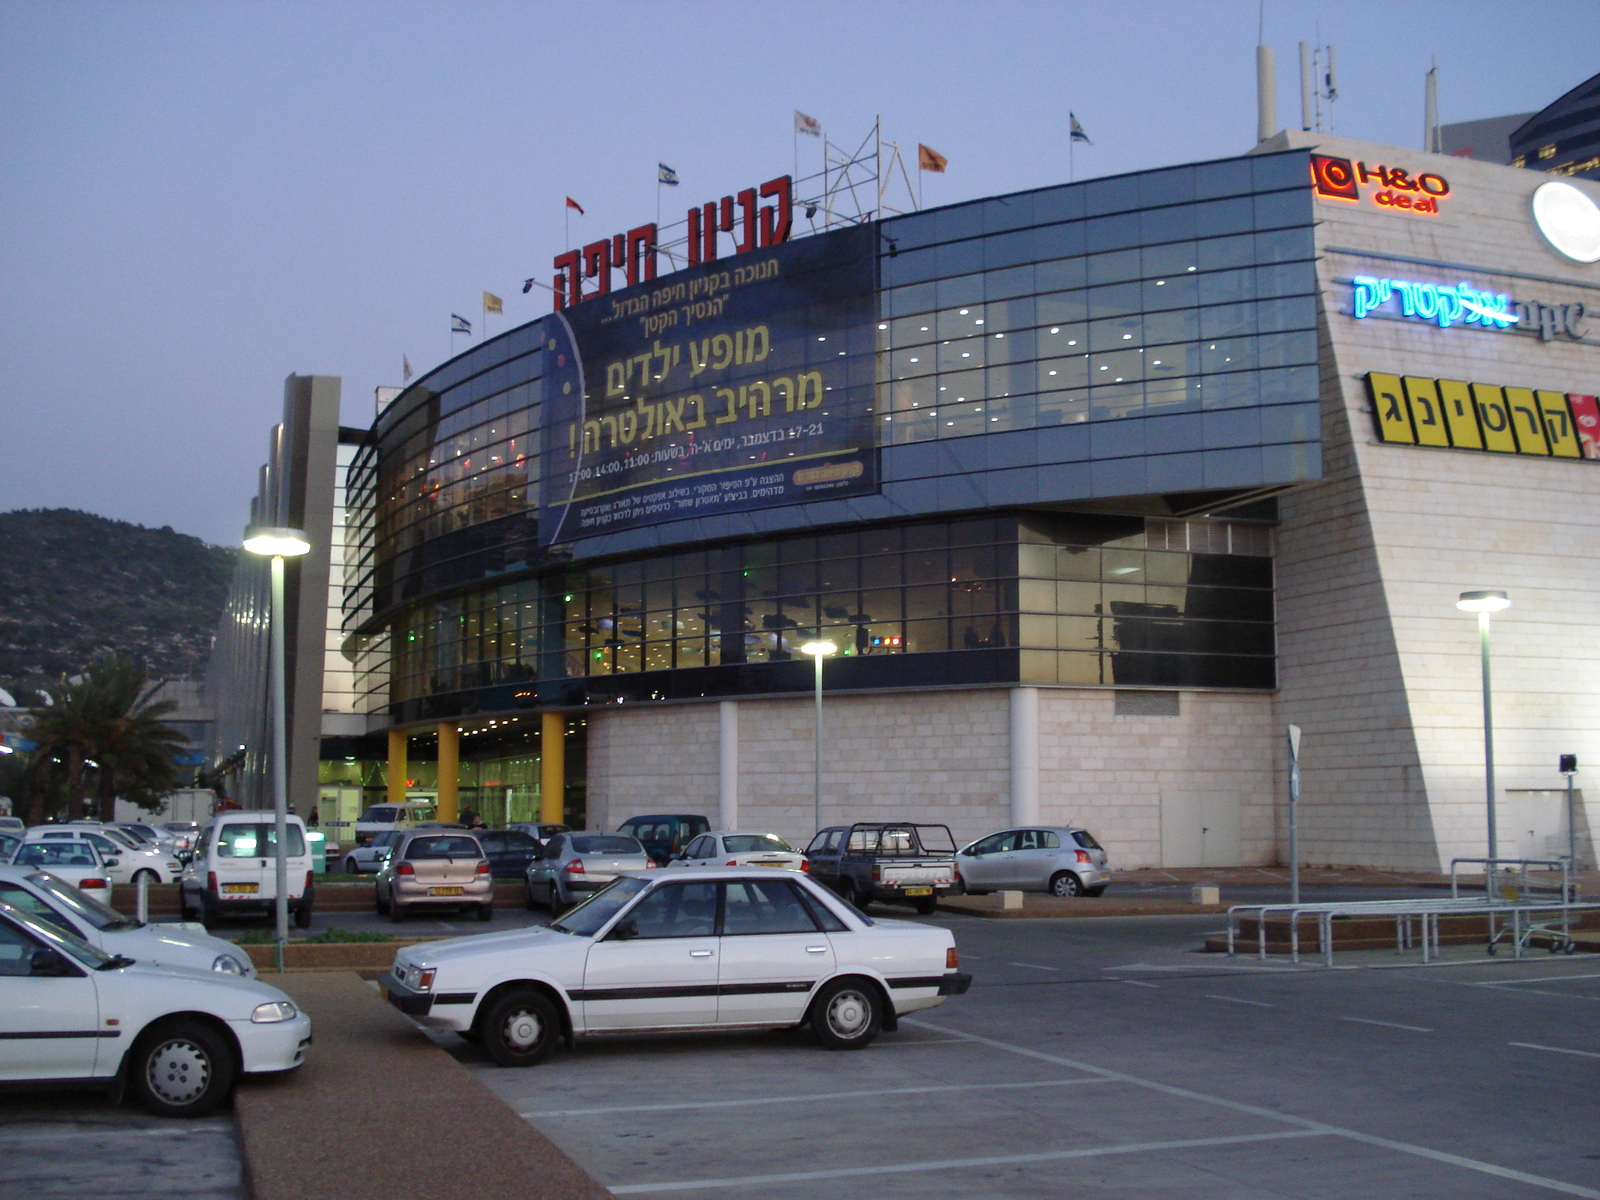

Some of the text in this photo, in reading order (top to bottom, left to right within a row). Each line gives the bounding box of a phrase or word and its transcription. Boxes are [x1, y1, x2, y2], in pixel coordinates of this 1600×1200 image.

[1357, 161, 1451, 198] H&O
[1374, 190, 1439, 214] deal
[553, 174, 793, 313] קניון חיפה
[688, 271, 731, 301] בקניון
[734, 258, 780, 285] חנוכה
[651, 282, 686, 308] חיפה
[1353, 274, 1518, 328] אלקטריק
[606, 325, 770, 397] מופע ילדים
[569, 370, 823, 459] מרהיב באולטרה!
[1381, 392, 1568, 444] קרטינג
[713, 438, 735, 452] ימים
[736, 428, 785, 449] בדצמבר,
[788, 422, 824, 439] 17-21
